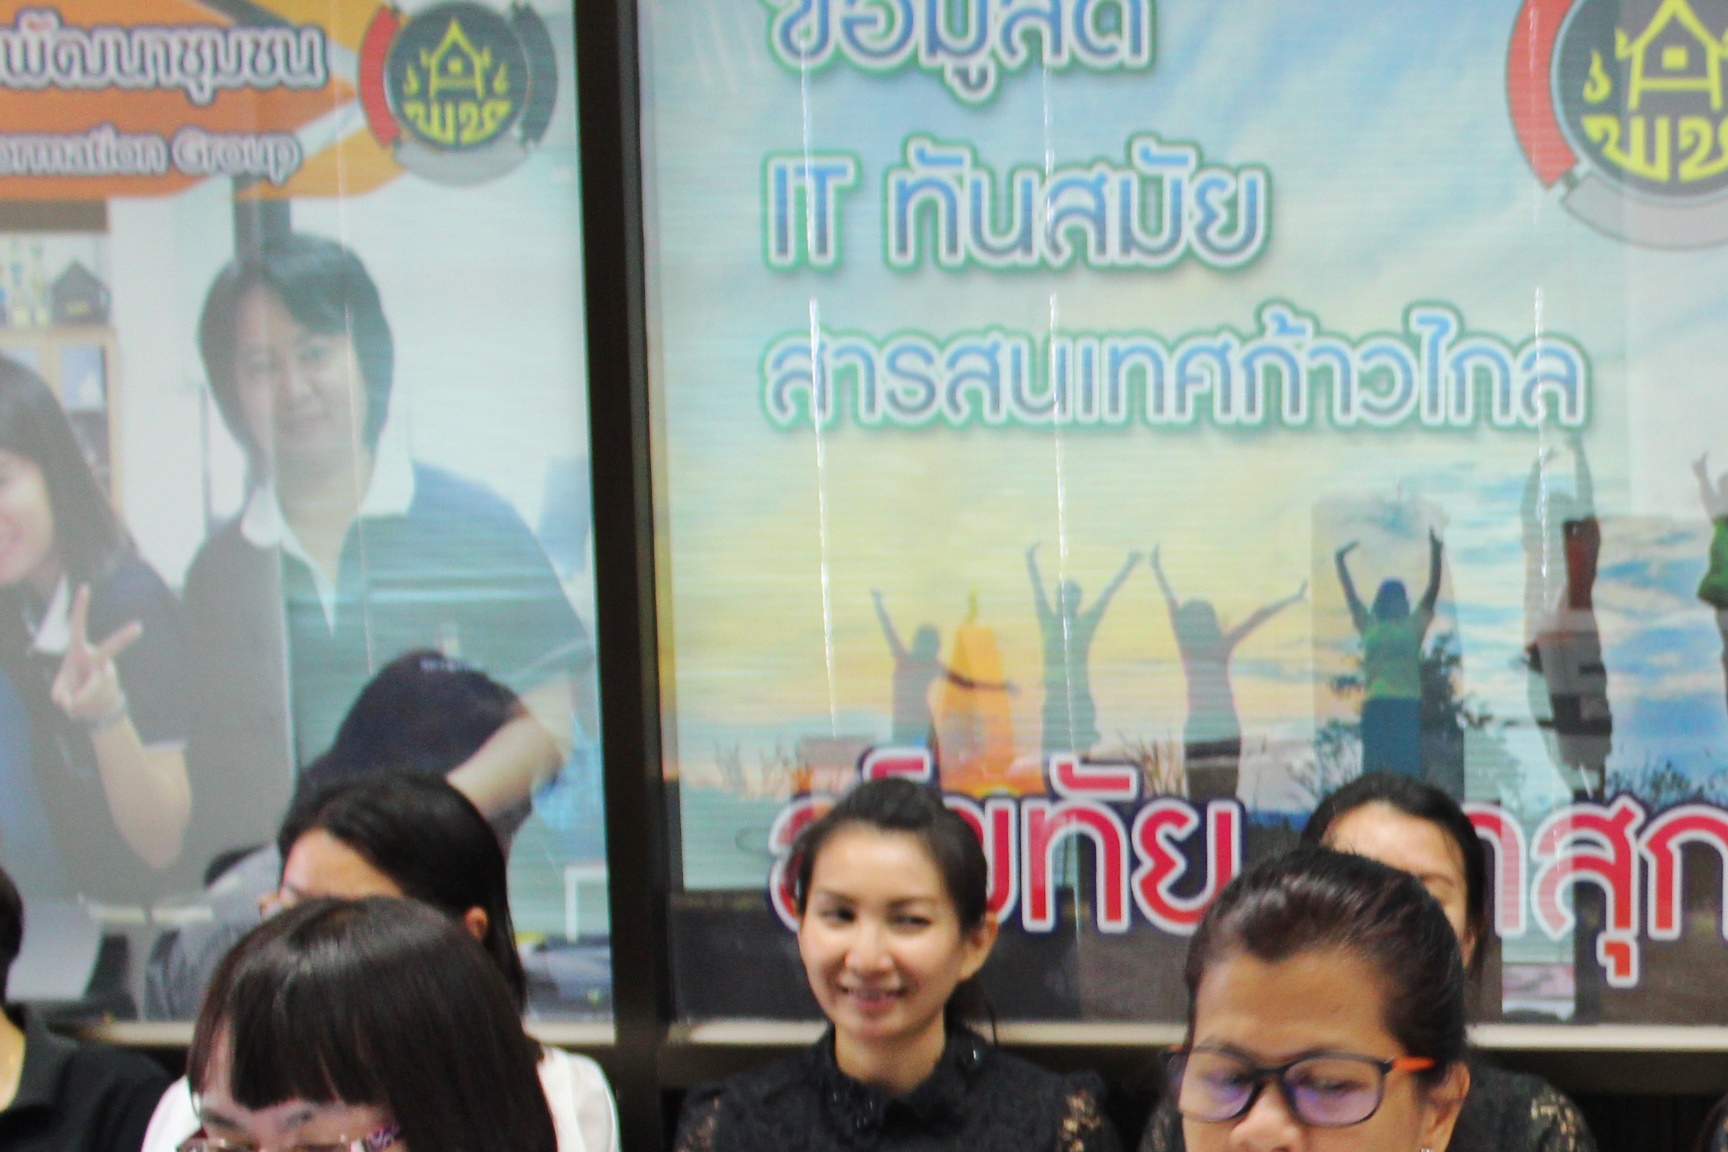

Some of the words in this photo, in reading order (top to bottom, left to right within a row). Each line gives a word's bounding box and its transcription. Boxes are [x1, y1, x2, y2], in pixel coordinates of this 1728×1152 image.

[172, 124, 302, 186] Group
[766, 155, 858, 267] IT
[887, 136, 1269, 267] ทันสมัย
[764, 302, 1590, 426] สารสนเทศก้าวไกล
